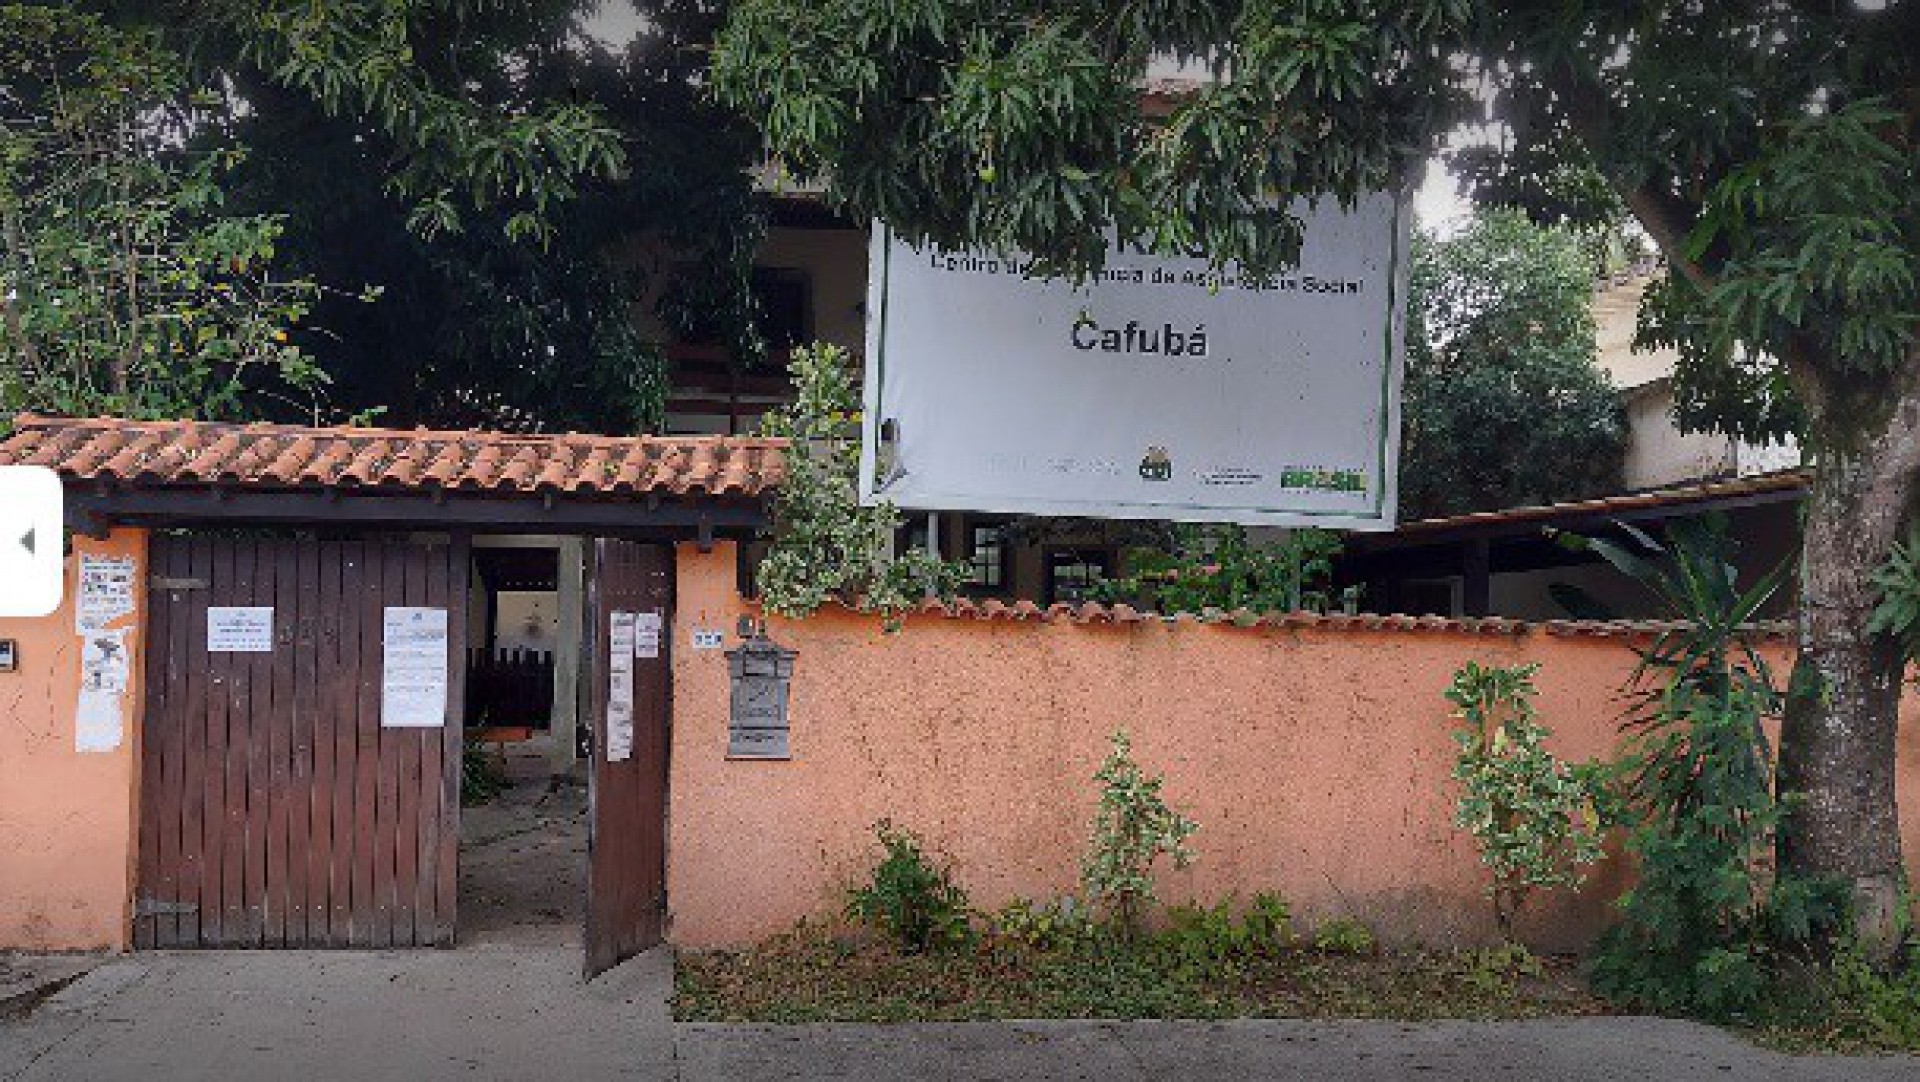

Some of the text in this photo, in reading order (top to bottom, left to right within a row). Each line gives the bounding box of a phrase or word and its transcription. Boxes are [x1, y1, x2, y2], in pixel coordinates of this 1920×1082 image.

[931, 253, 998, 274] Centro
[1152, 267, 1175, 283] de
[1183, 266, 1298, 291] Asistncia
[1303, 276, 1364, 294] Social
[1072, 320, 1206, 356] Cafubá
